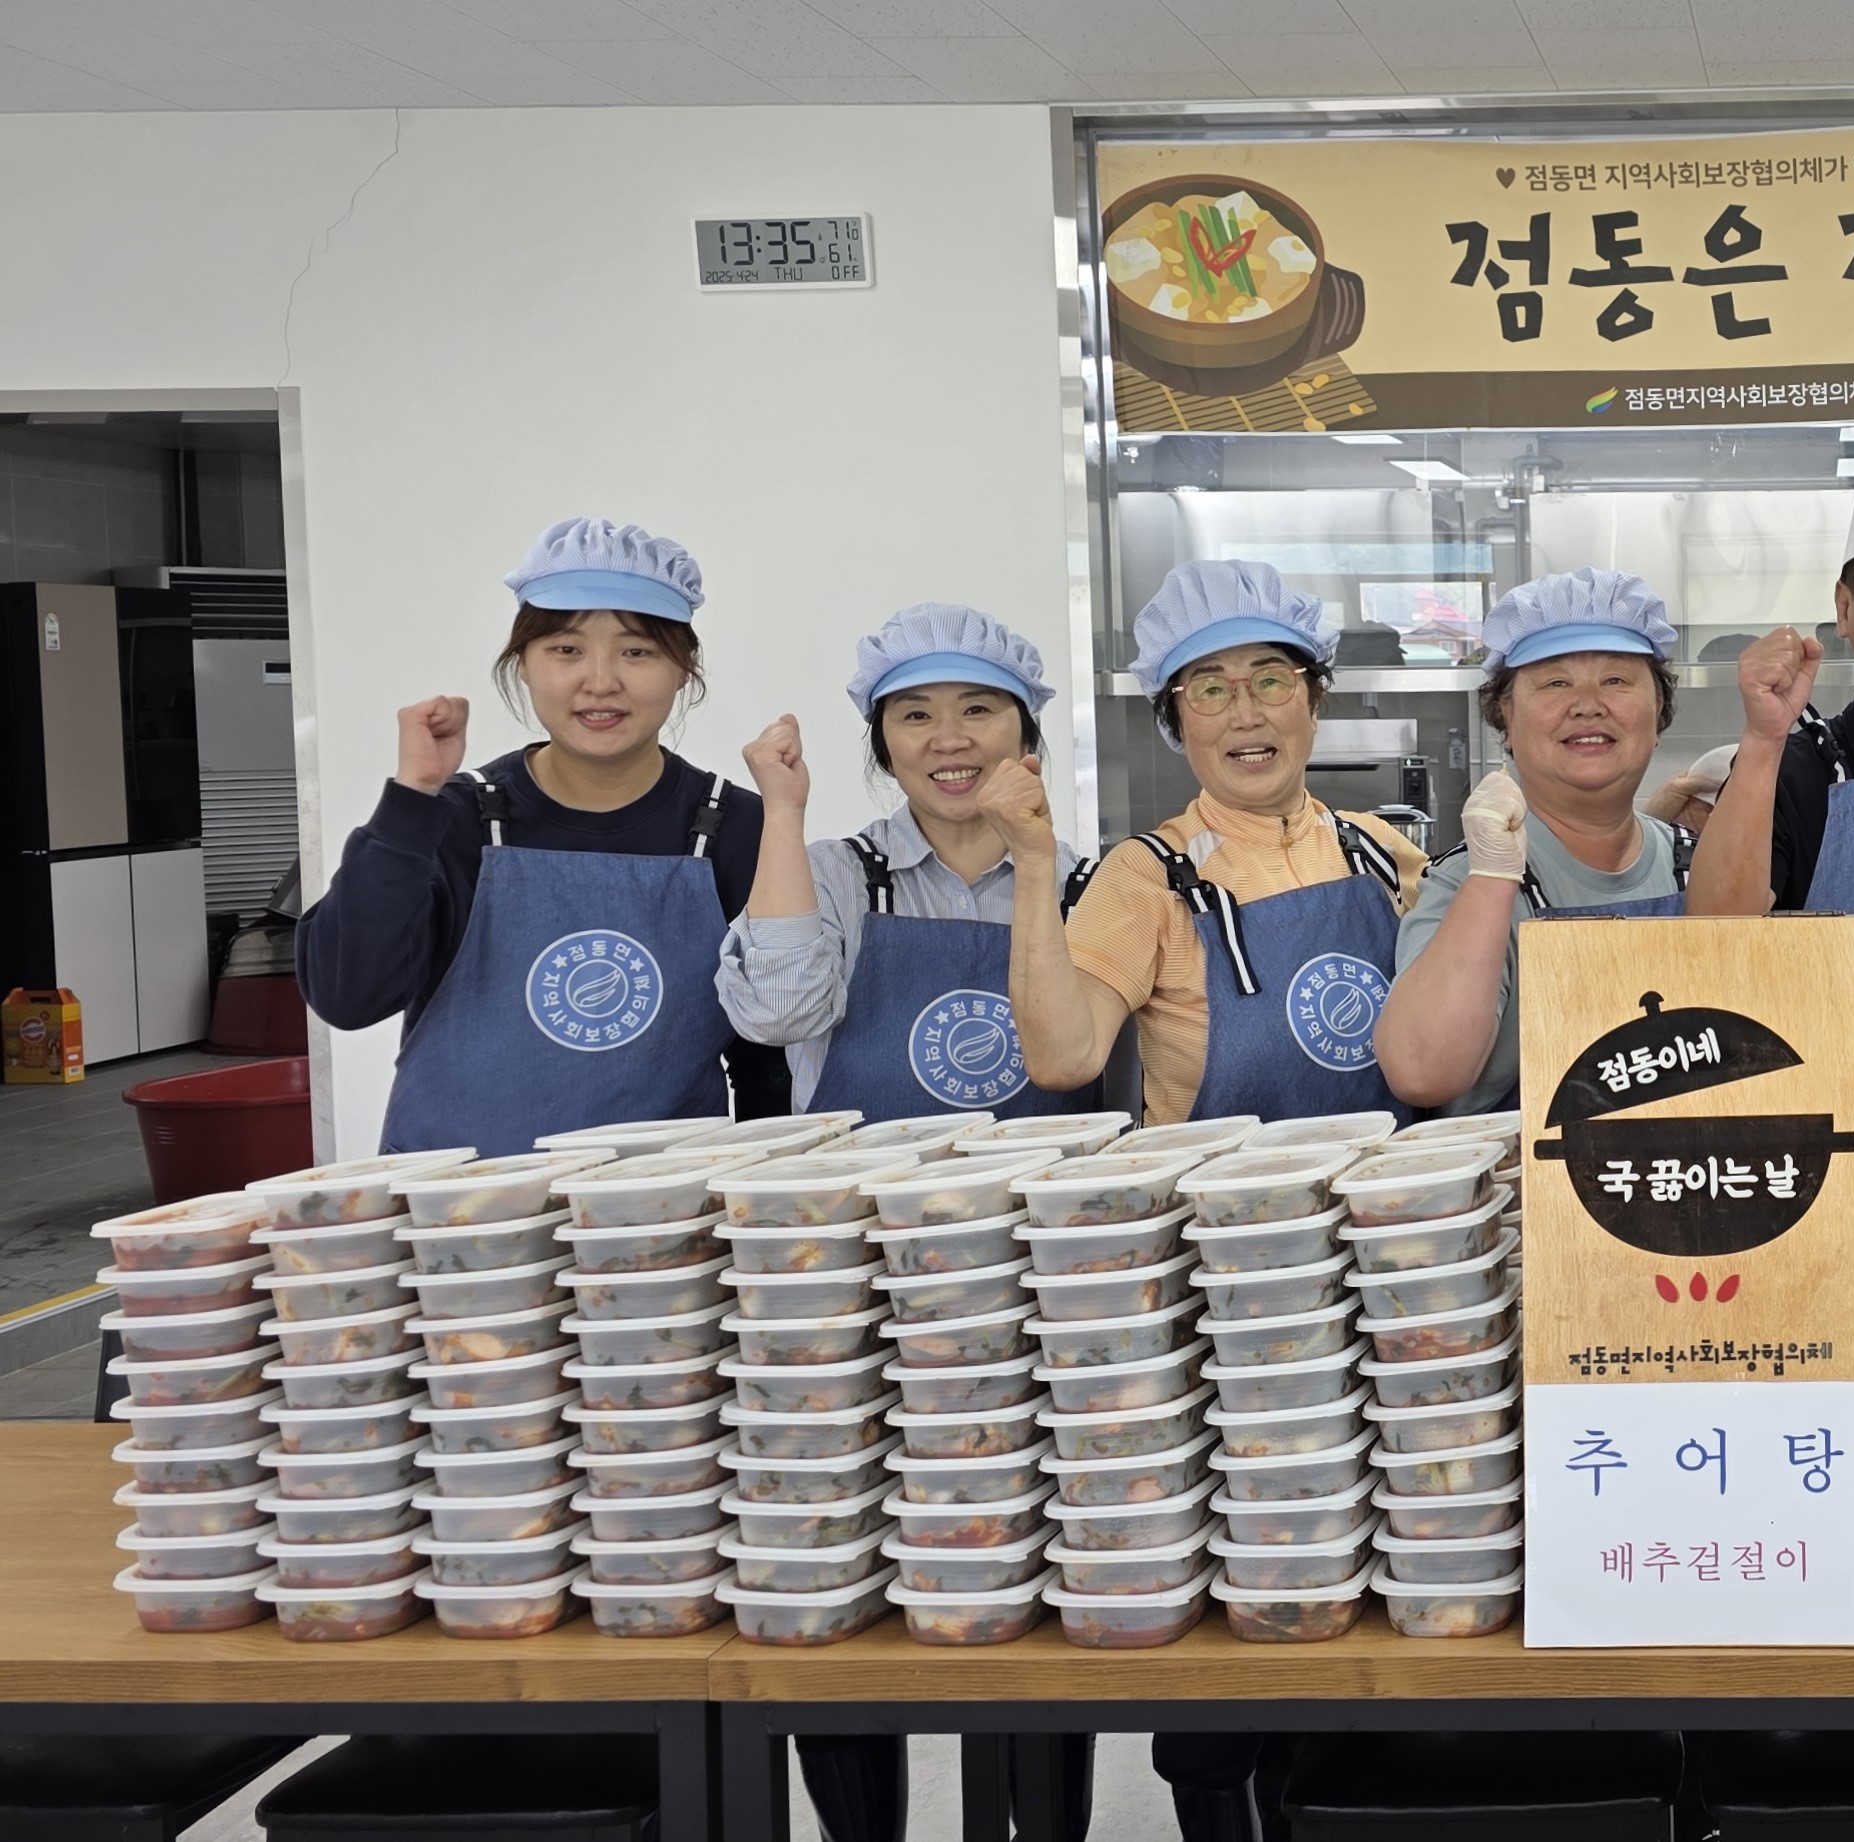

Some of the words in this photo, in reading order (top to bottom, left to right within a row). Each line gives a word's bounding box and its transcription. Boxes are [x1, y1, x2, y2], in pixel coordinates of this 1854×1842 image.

[1524, 163, 1598, 192] 점동면
[1604, 155, 1849, 190] 지역사회보장협의체가
[718, 221, 817, 266] 13:35
[774, 267, 803, 282] THU
[1444, 203, 1789, 343] 점동은
[567, 940, 632, 963] 점동면
[1307, 962, 1357, 991] 점동면
[950, 1000, 1011, 1021] 점동면
[1596, 1028, 1722, 1092] 점동이네
[1597, 1160, 1641, 1203] 국
[1646, 1155, 1759, 1203] 끓이는
[1765, 1154, 1800, 1200] 날
[1568, 1339, 1833, 1376] 점동면지역사회보장협의체
[1599, 1539, 1811, 1584] 배추겉절이
